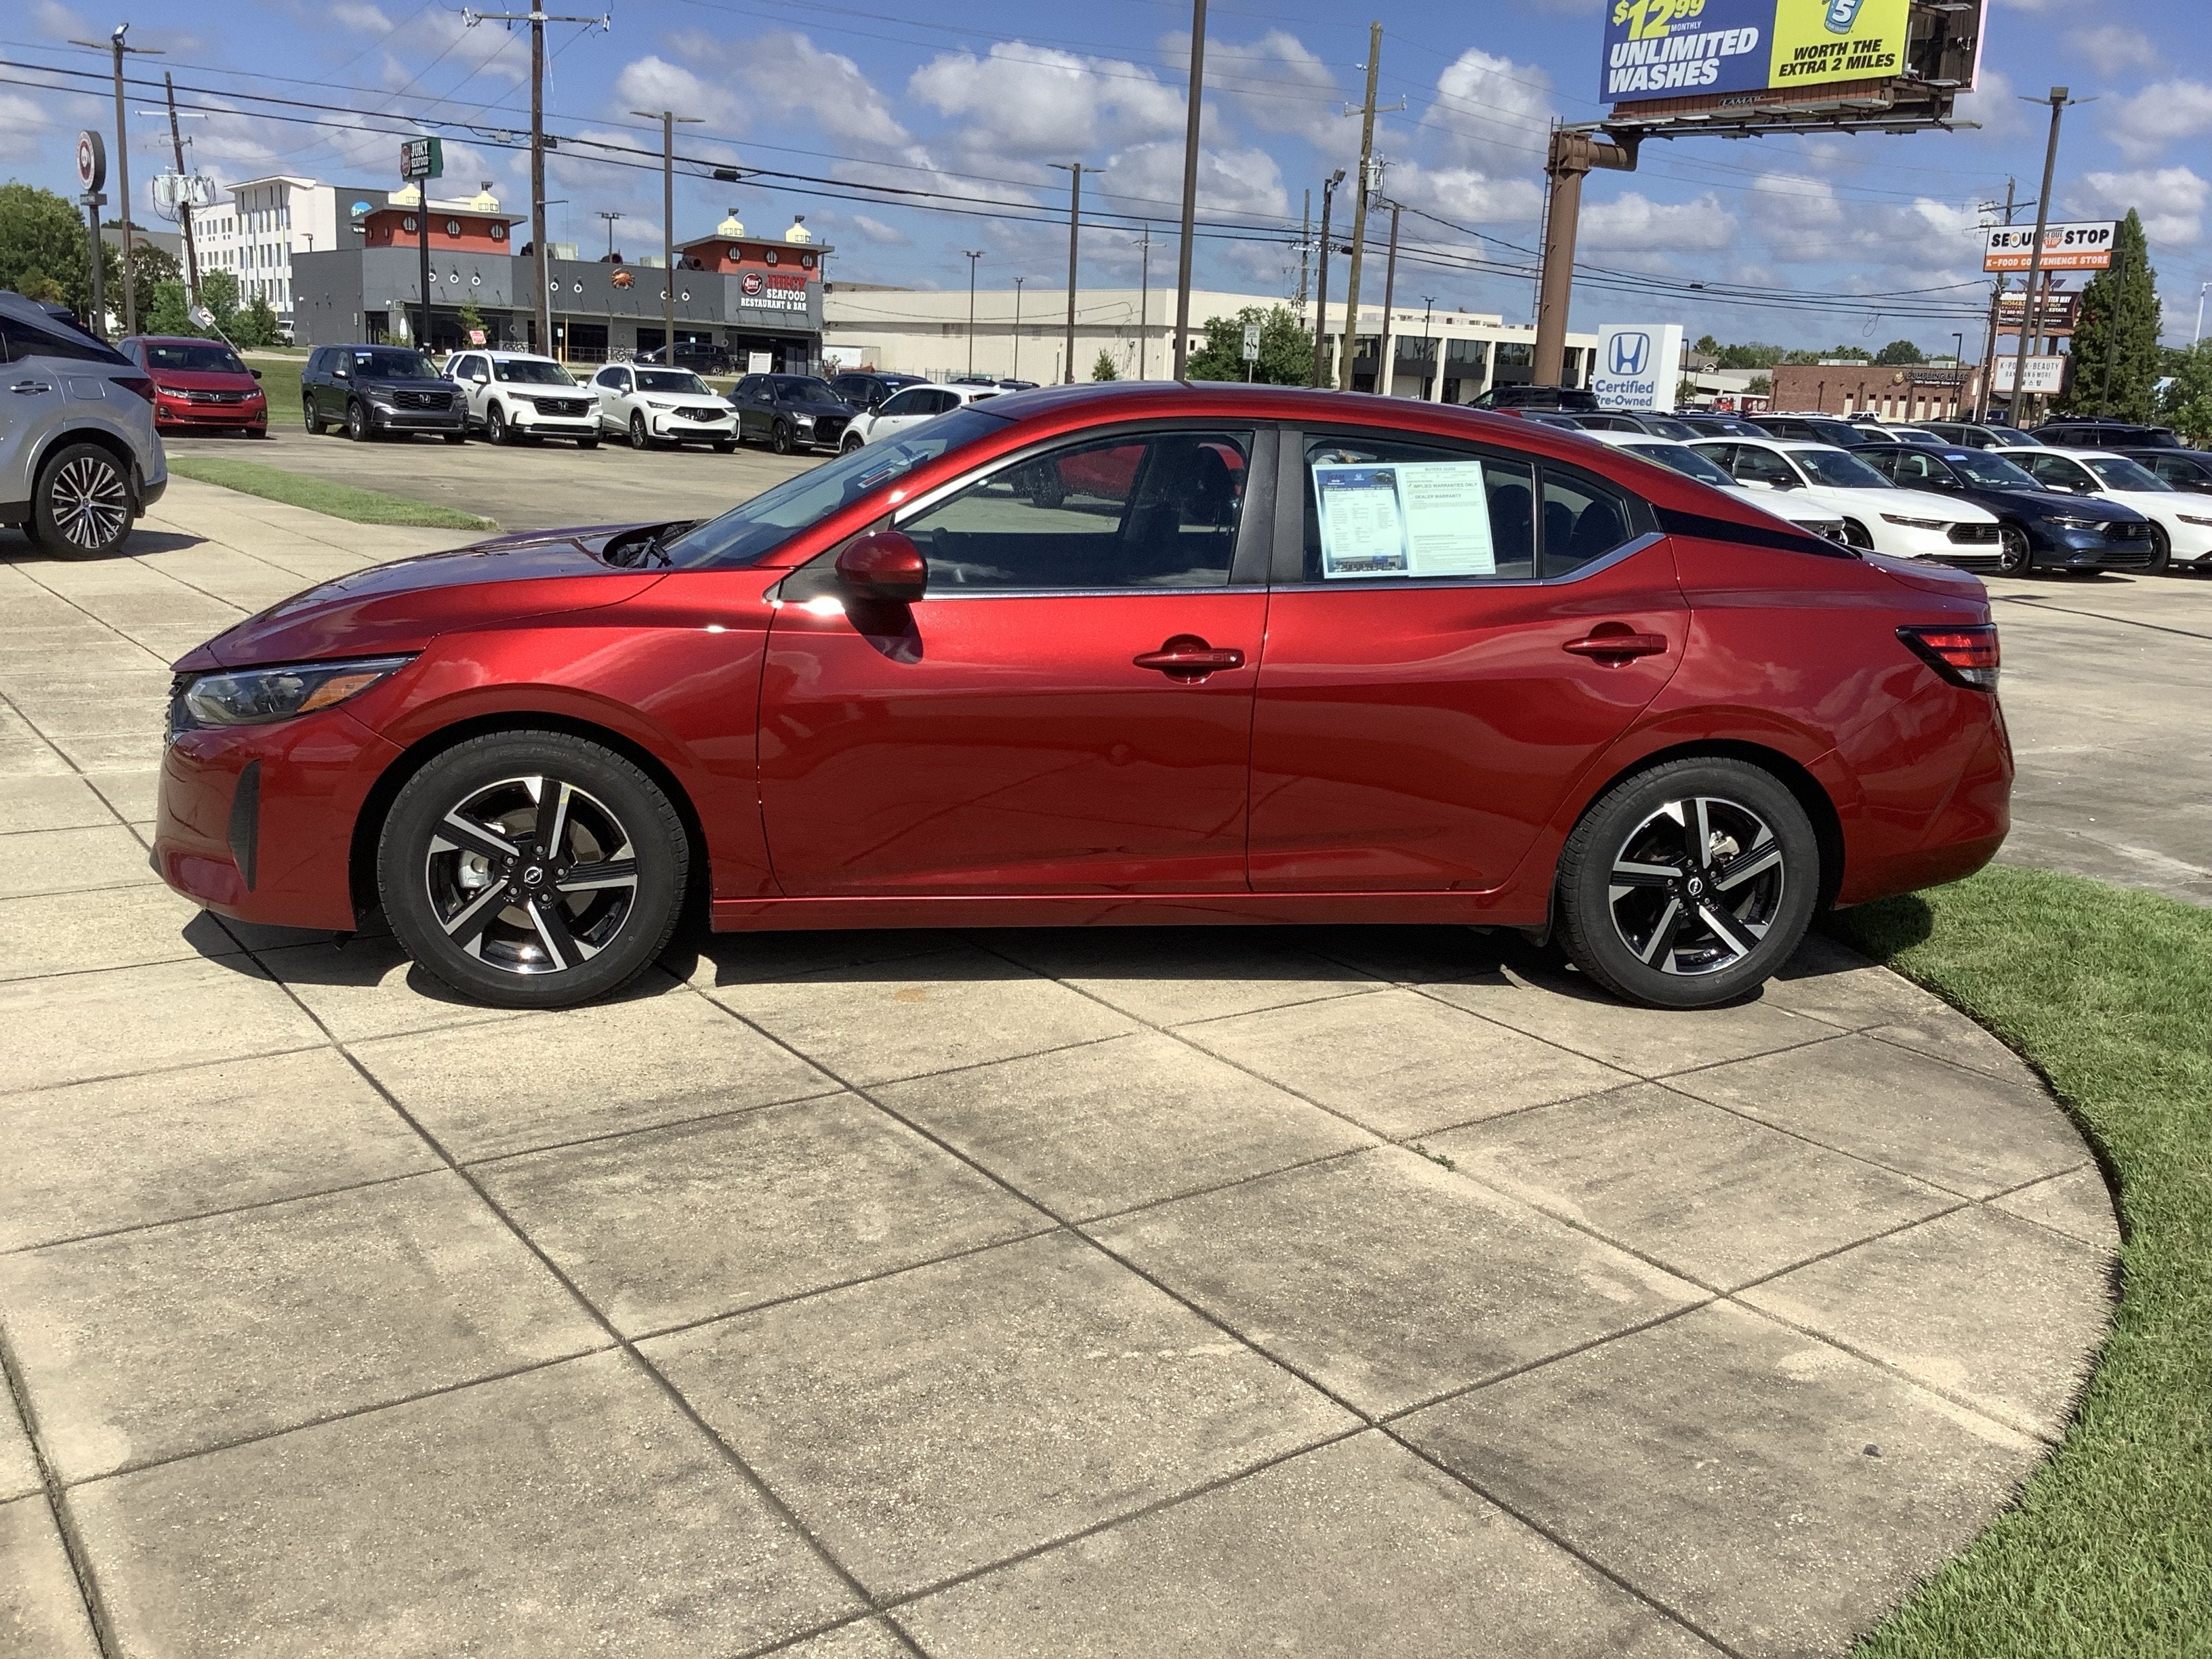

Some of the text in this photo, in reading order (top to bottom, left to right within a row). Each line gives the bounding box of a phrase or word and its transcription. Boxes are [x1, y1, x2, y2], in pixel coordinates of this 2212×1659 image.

[1671, 21, 1702, 32] MONTHLY
[1610, 27, 1759, 68] UNLIMITED
[1794, 39, 1883, 61] WORTH THE
[1778, 54, 1896, 77] EXTRA 2 MILES
[1609, 58, 1720, 94] WASHES
[411, 141, 428, 158] JUICY
[2064, 229, 2109, 245] STOP
[1986, 255, 2108, 267] K-FOOD COENIENCE STORE
[765, 274, 806, 291] JUICY
[766, 289, 806, 301] SEAFOOD
[741, 298, 806, 311] RESTAURANT & BAR
[1595, 380, 1654, 394] Certified
[1595, 394, 1653, 407] Pre-Owned
